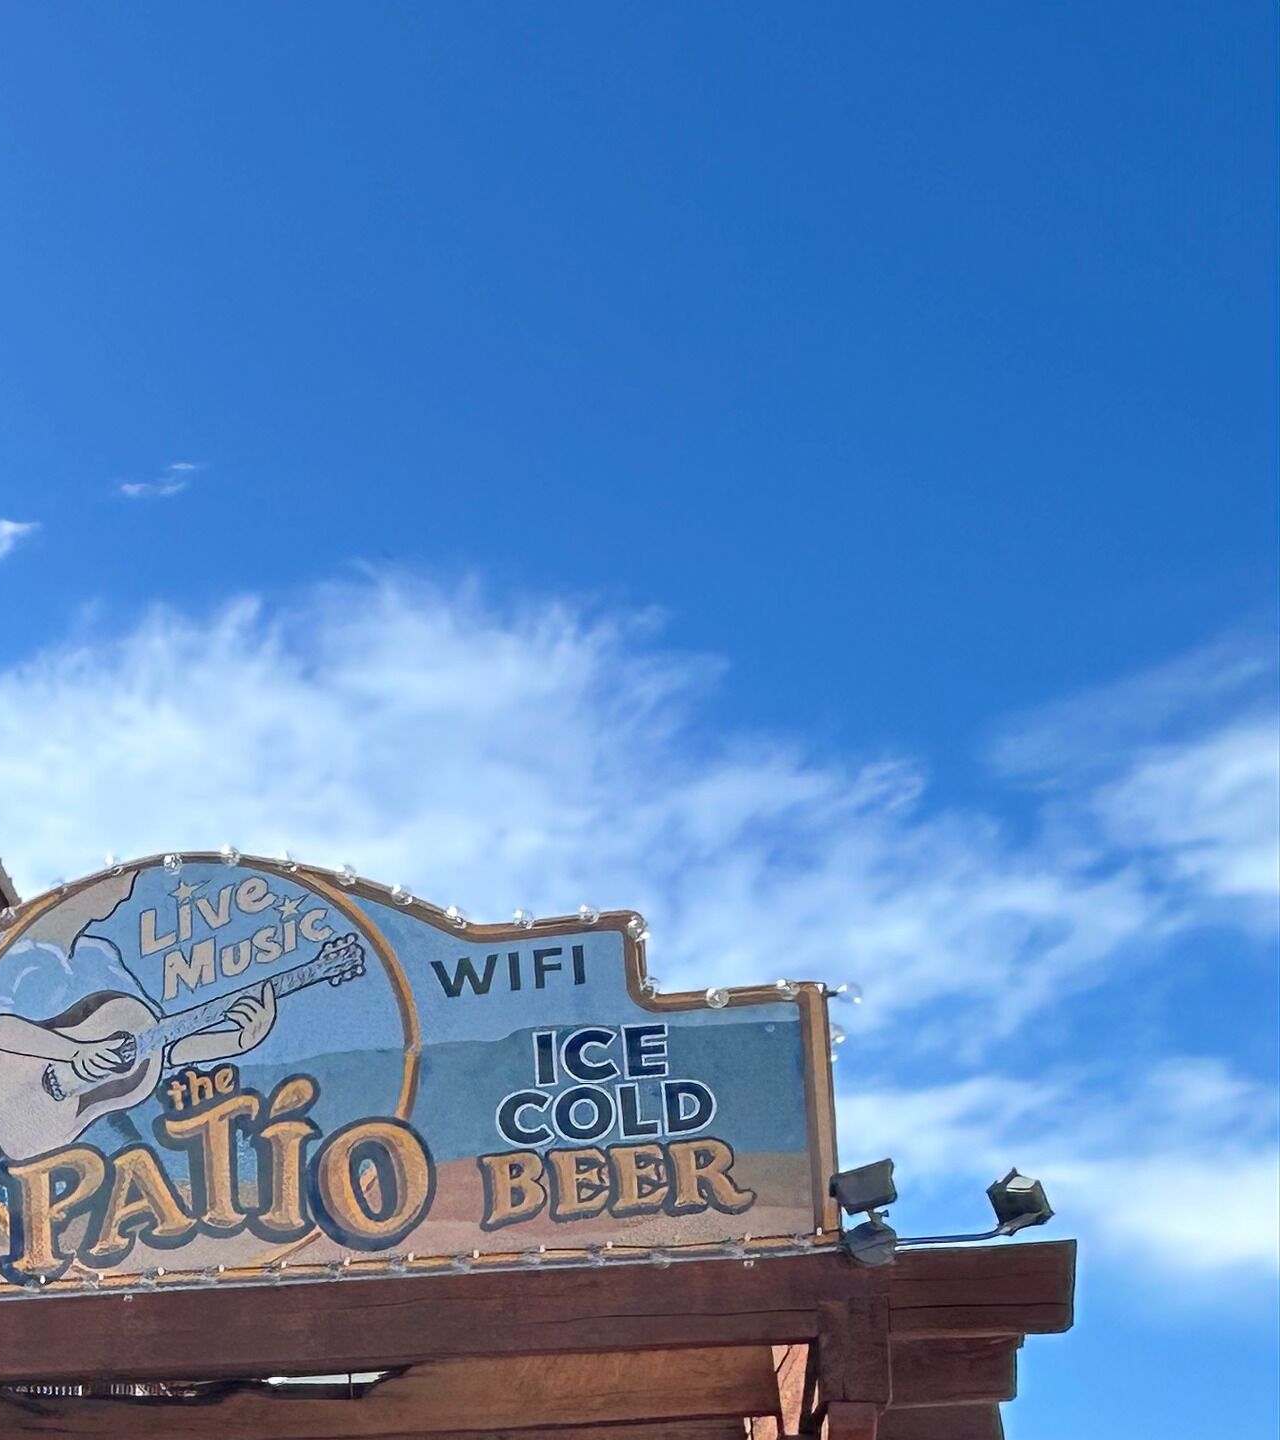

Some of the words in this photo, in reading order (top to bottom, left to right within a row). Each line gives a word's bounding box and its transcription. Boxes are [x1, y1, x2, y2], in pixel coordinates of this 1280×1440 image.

[140, 876, 277, 957] Live
[163, 896, 335, 1001] Music
[430, 944, 587, 998] WIFI
[166, 1063, 237, 1112] the
[532, 1022, 670, 1087] ICE
[495, 1078, 717, 1148] COLD
[477, 1137, 758, 1232] BEER
